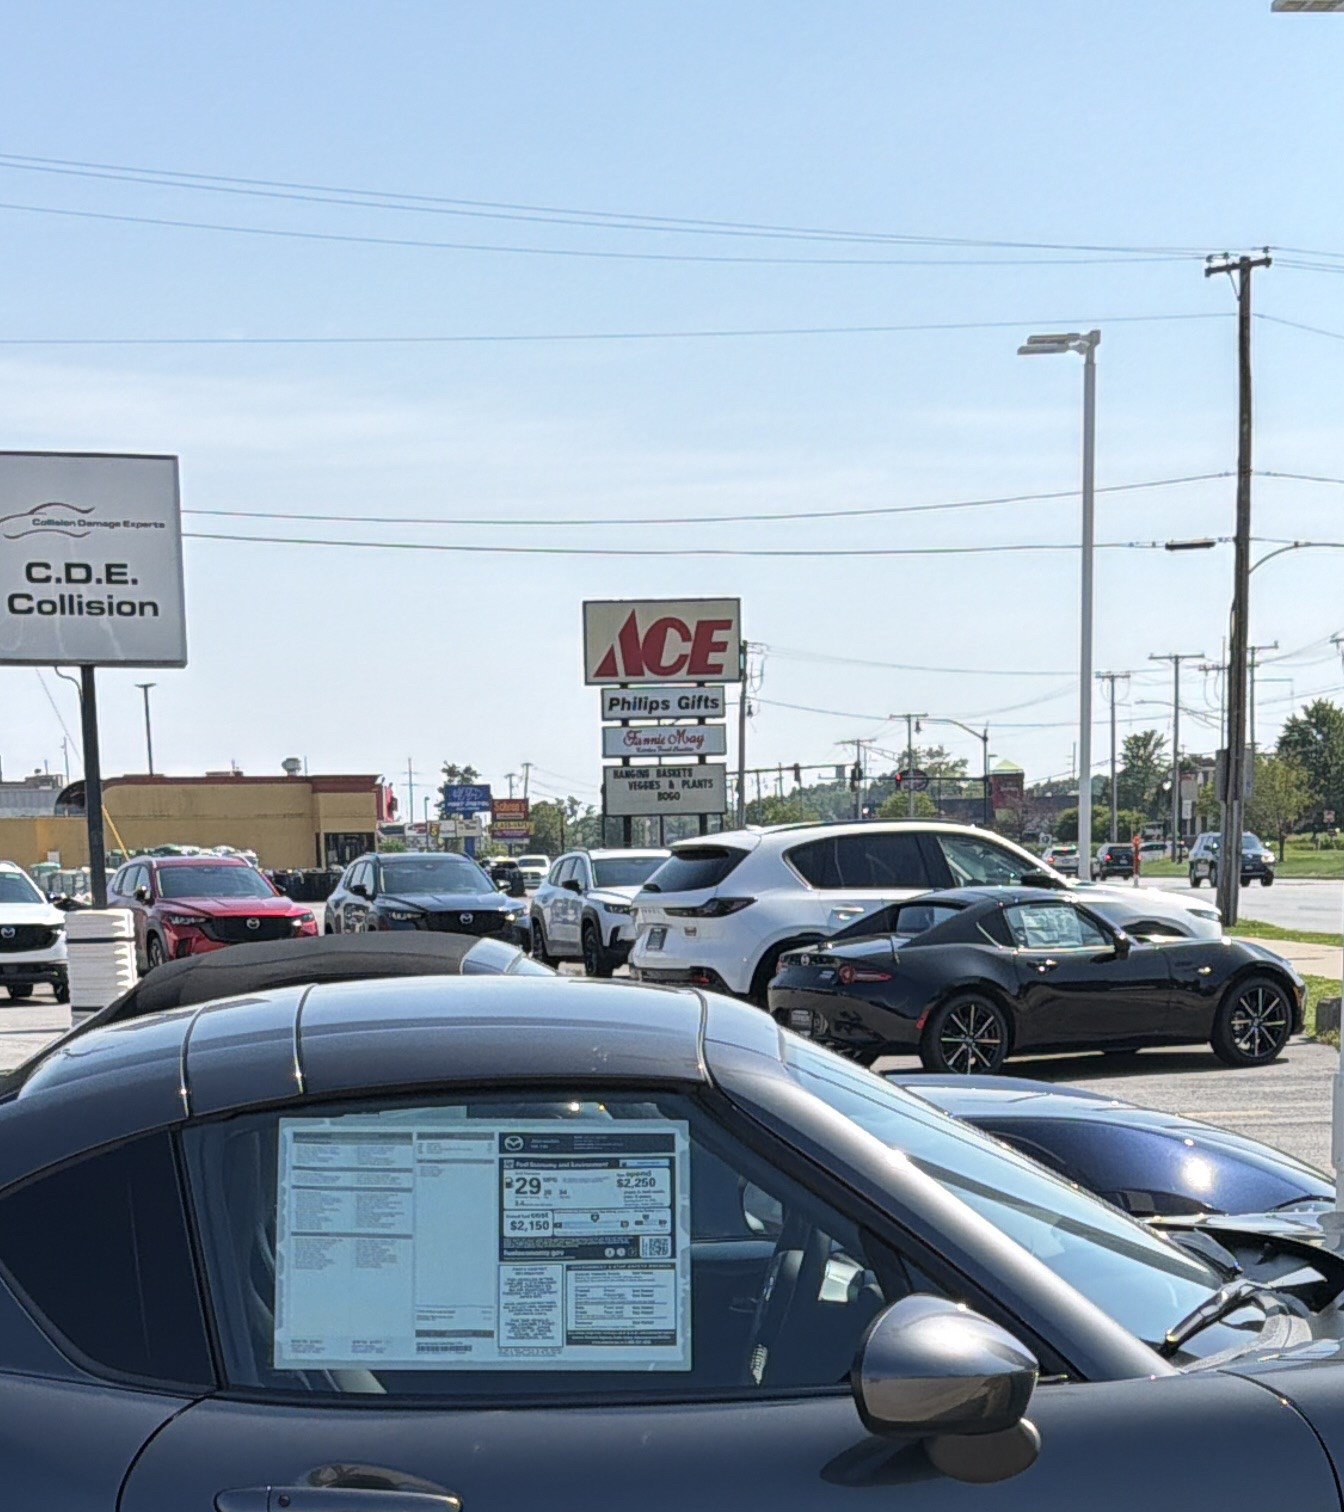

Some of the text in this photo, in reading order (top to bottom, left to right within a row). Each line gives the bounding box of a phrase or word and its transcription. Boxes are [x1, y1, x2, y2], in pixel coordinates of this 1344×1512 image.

[77, 520, 121, 529] Damage
[123, 520, 165, 529] Experts
[25, 561, 139, 586] C.D.E.
[7, 593, 159, 617] Collision
[593, 608, 733, 678] ACE
[608, 694, 720, 714] Philips Gifts
[623, 728, 705, 750] Fannie May
[613, 767, 693, 779] HANGING BASKETS
[628, 780, 661, 790] VEGGIES
[681, 778, 714, 789] PLANTS
[515, 1177, 541, 1195] 29
[510, 1220, 550, 1232] $2,150
